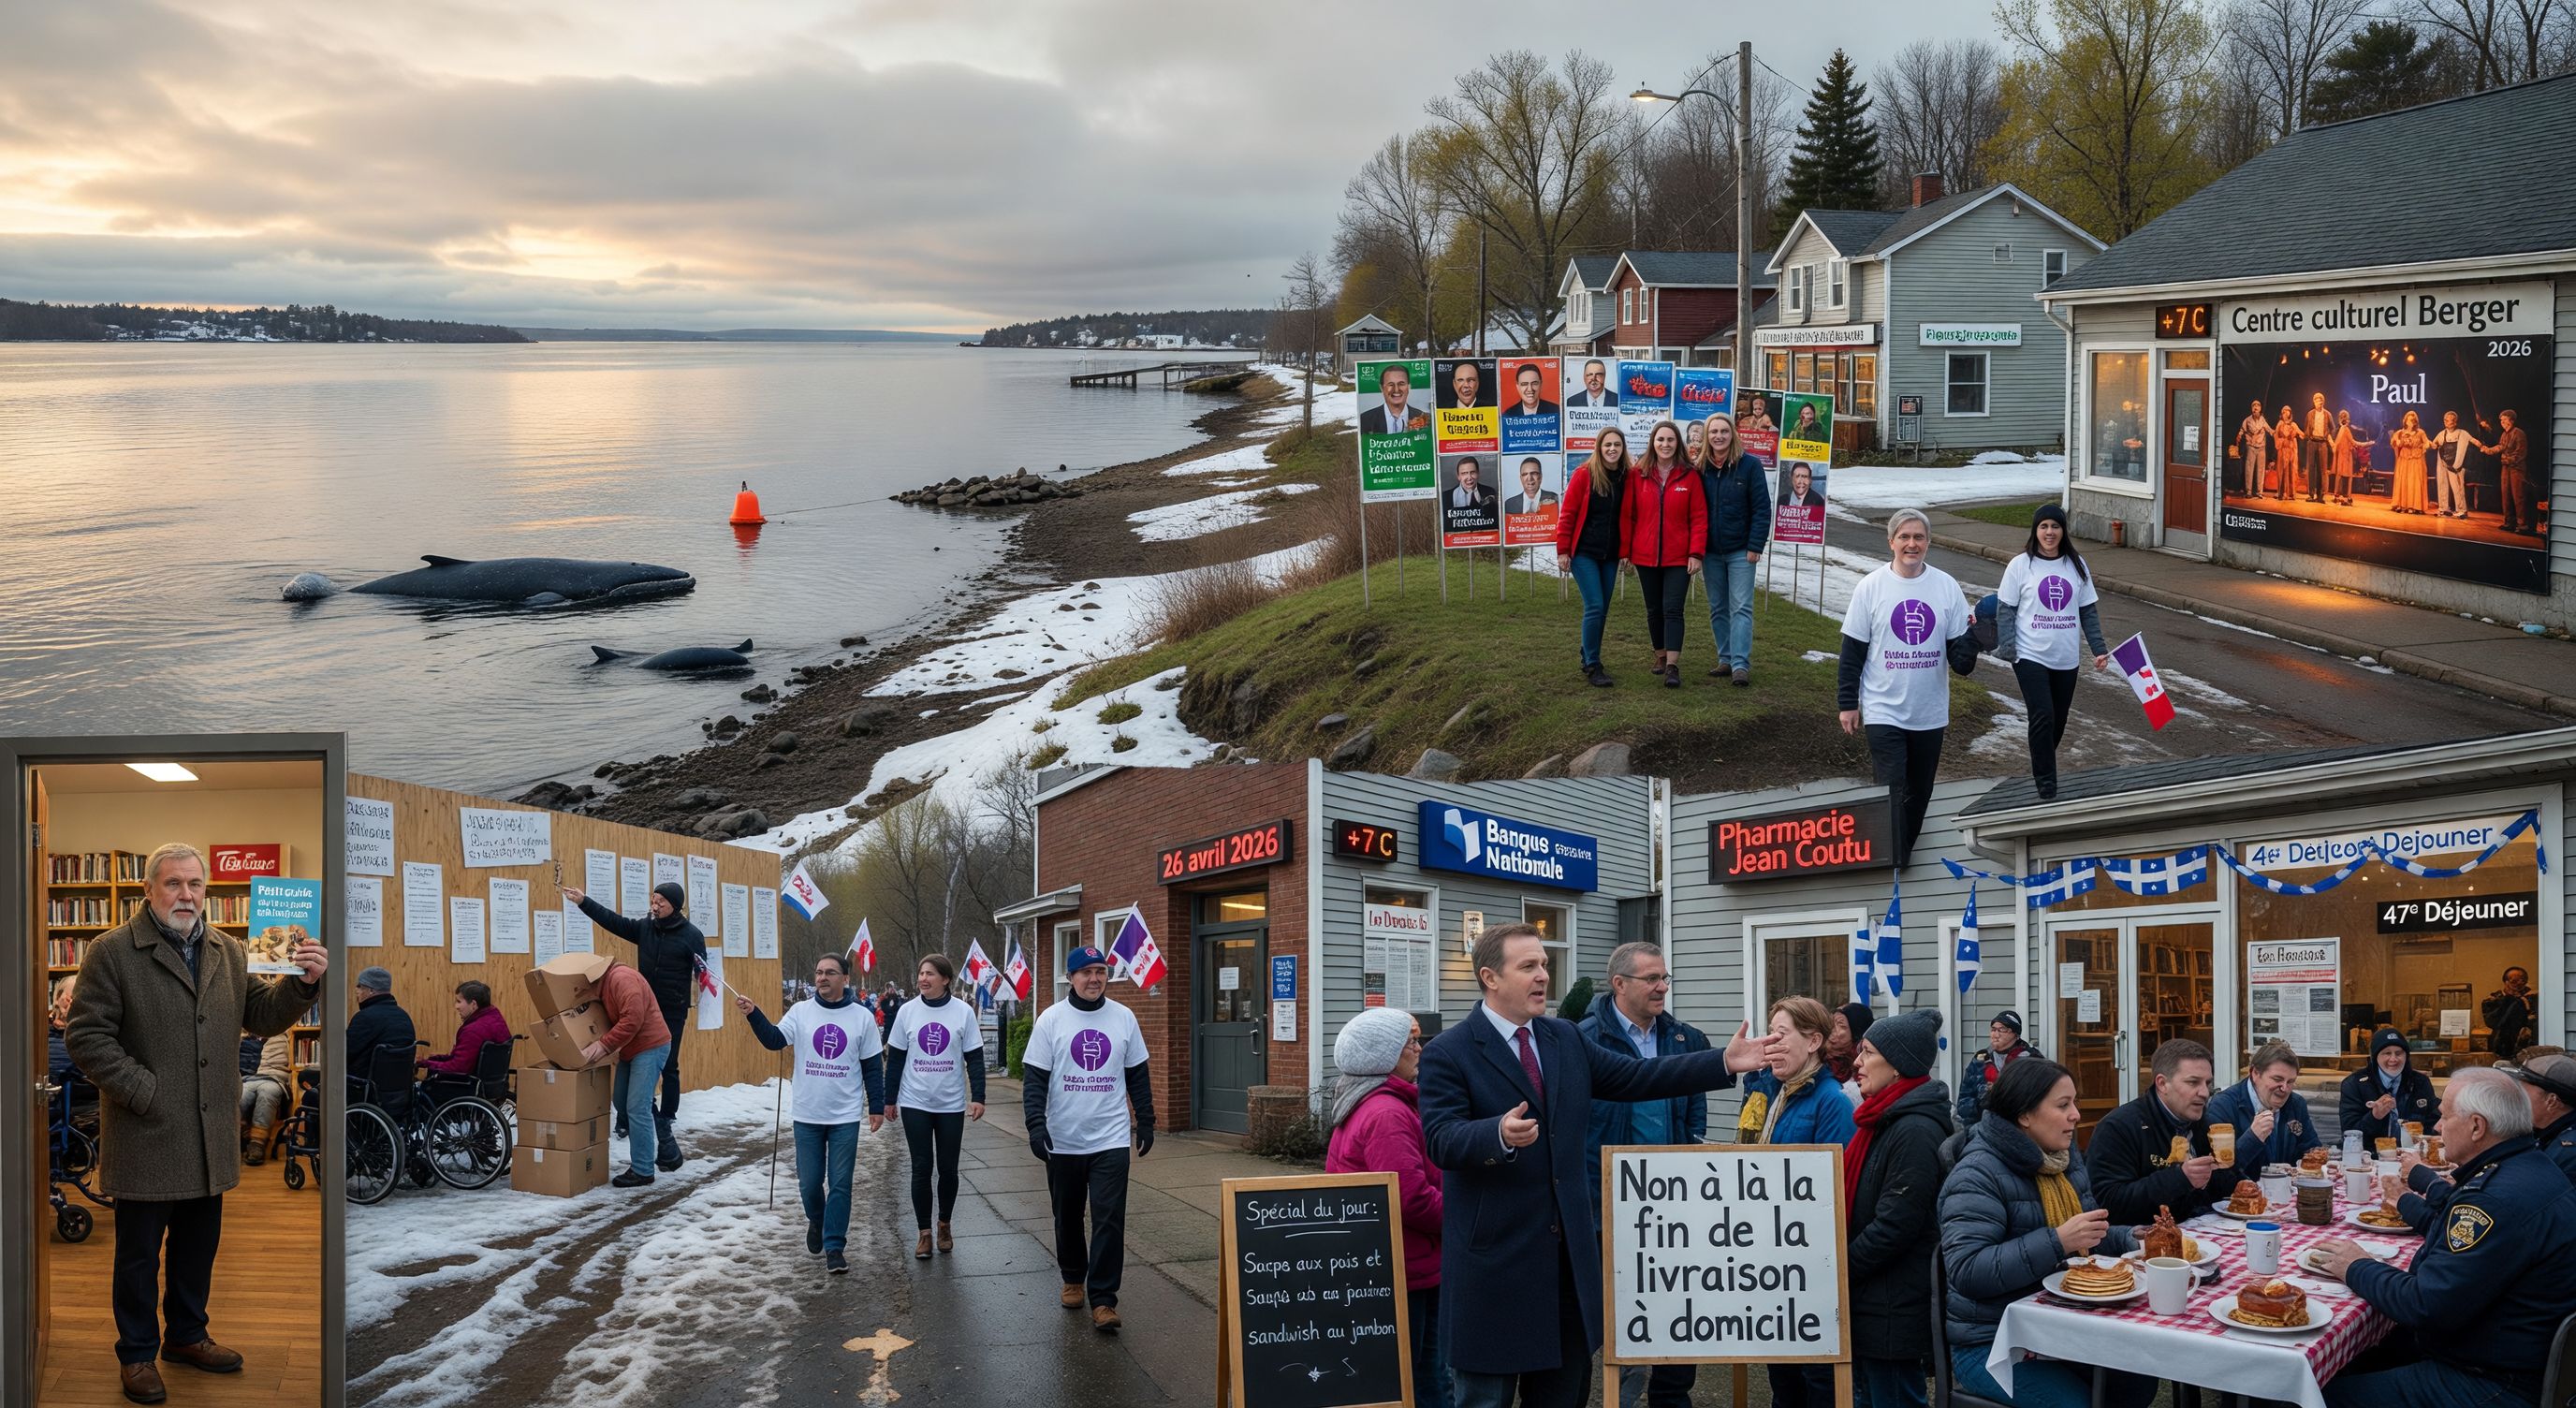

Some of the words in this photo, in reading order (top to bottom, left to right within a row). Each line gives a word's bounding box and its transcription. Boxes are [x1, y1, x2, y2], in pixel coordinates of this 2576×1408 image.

[2232, 306, 2304, 334] Centre
[2311, 295, 2407, 330] culturel
[2419, 294, 2520, 333] Berger
[2487, 340, 2532, 358] 2026
[2370, 374, 2427, 403] Paul
[1719, 810, 1855, 850] Pharmacie
[1163, 850, 1183, 878] 26
[1188, 838, 1225, 873] avril
[1230, 827, 1279, 864] 2026
[1729, 848, 1788, 874] Jean
[1794, 836, 1870, 867] Coutu
[2424, 900, 2529, 926] Déjeuner
[1620, 1158, 1688, 1201] Non
[1700, 1162, 1723, 1201] à
[1737, 1158, 1769, 1201] là
[1784, 1158, 1816, 1201] la
[1246, 1198, 1307, 1225] Spécial
[1313, 1198, 1334, 1217] du
[1633, 1206, 1689, 1248] fin
[1708, 1206, 1754, 1247] de
[1774, 1205, 1809, 1247] la
[1296, 1258, 1323, 1271] aux
[1366, 1249, 1383, 1267] et
[1636, 1252, 1807, 1293] livraison
[1248, 1320, 1320, 1345] sandwish
[1327, 1327, 1345, 1339] au
[1350, 1318, 1396, 1345] jambon
[1627, 1299, 1652, 1342] à
[1669, 1298, 1822, 1342] domicile
